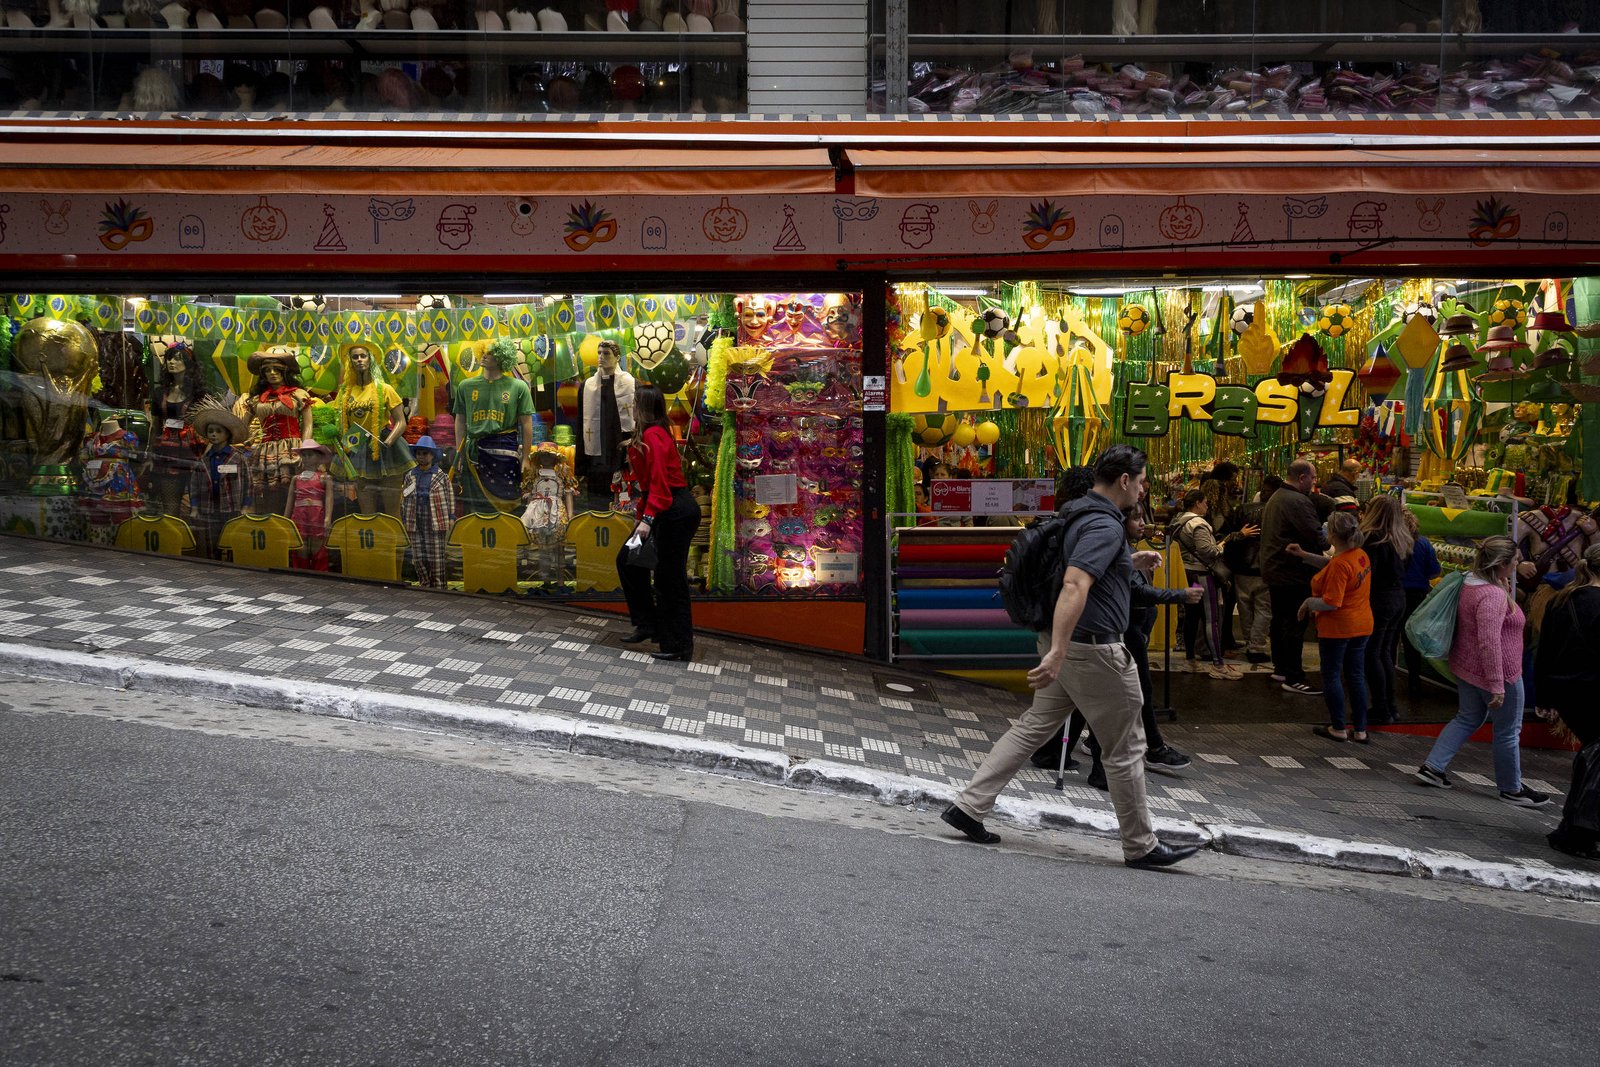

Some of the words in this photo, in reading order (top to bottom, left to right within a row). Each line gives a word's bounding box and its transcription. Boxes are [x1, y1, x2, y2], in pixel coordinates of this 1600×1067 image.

[471, 389, 479, 401] 8
[472, 409, 504, 423] BRASIL
[144, 529, 159, 552] 10
[251, 529, 265, 551] 10
[358, 528, 374, 550] 10
[480, 527, 496, 549] 10
[594, 526, 609, 547] 10
